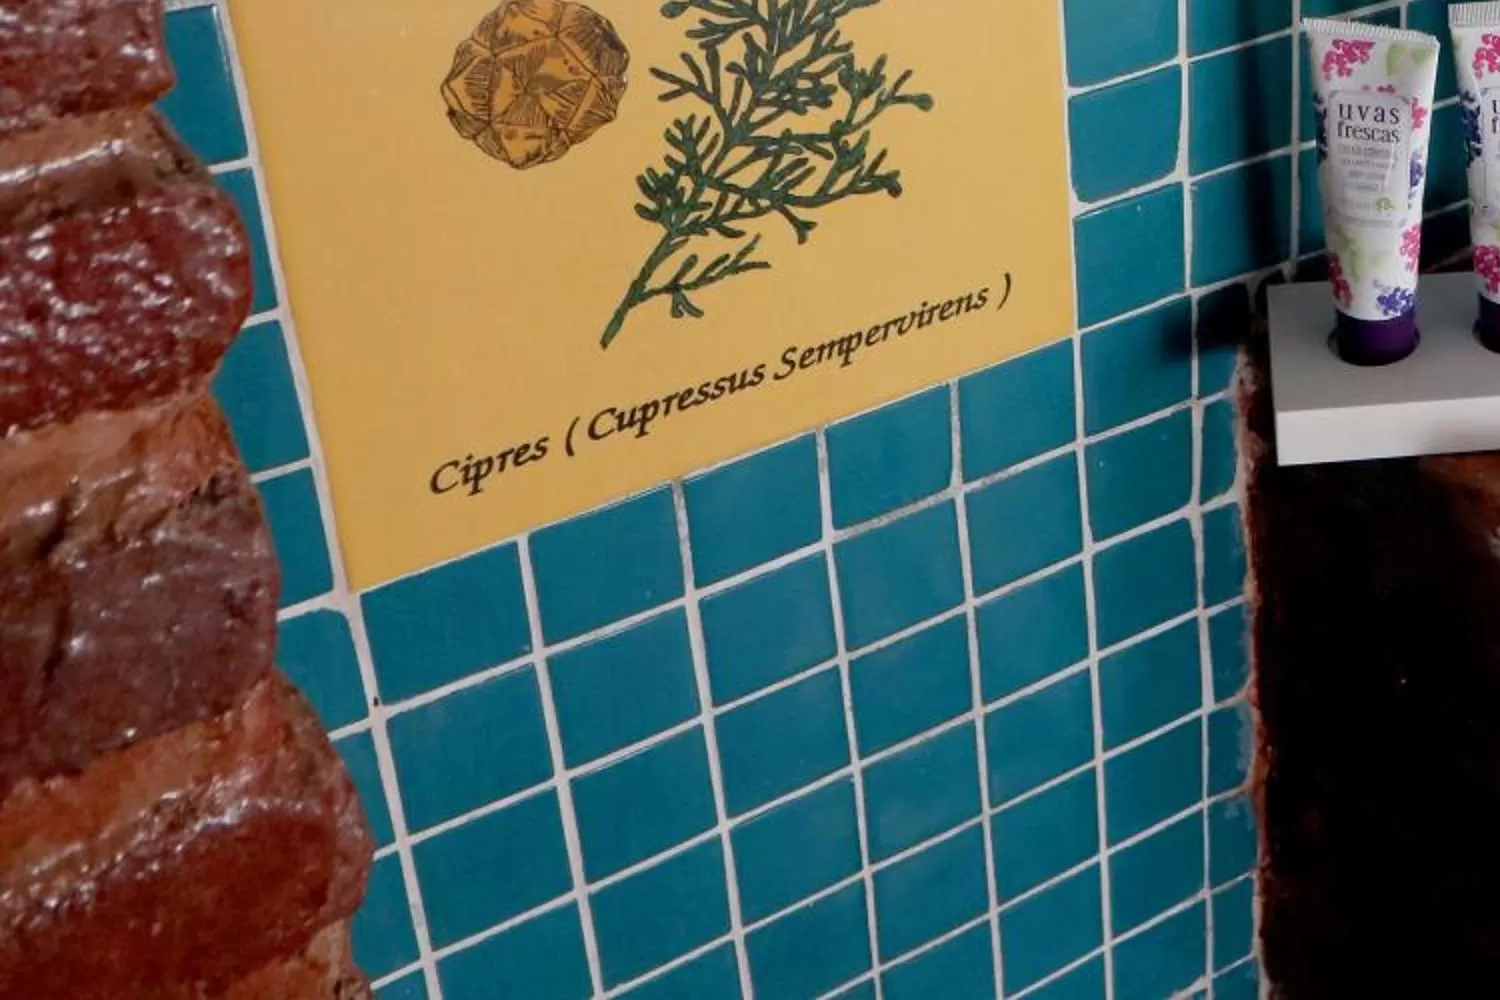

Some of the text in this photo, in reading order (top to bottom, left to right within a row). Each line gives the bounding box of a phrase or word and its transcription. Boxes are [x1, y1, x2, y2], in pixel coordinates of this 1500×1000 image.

[1338, 103, 1401, 124] uvas
[1336, 120, 1401, 143] frescas
[429, 434, 549, 497] Cipres
[587, 362, 766, 441] Cupressus
[773, 284, 990, 381] Sempervirens
